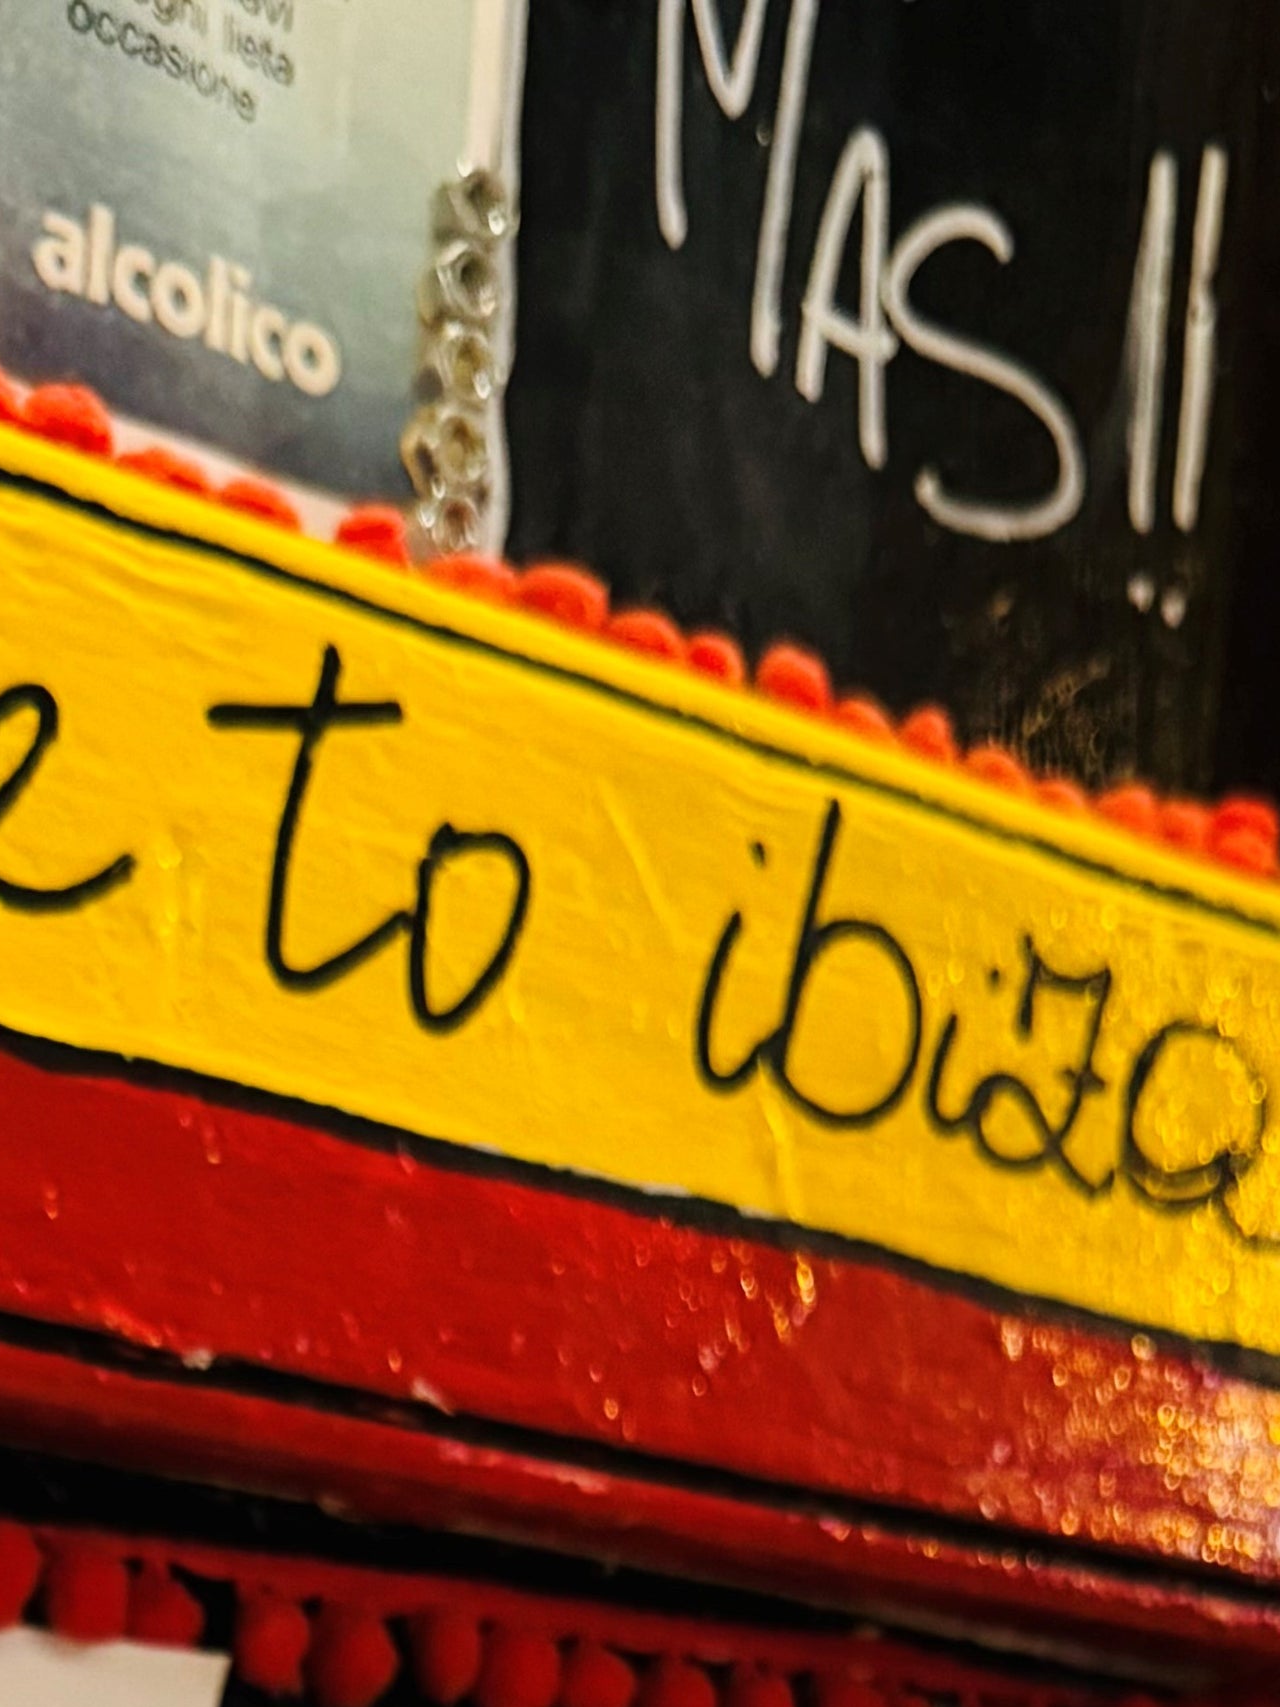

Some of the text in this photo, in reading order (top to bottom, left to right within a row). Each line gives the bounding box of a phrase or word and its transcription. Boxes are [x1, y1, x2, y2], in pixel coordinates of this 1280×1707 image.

[67, 0, 256, 124] occasione
[31, 206, 342, 397] alcolico
[204, 643, 531, 1034] to
